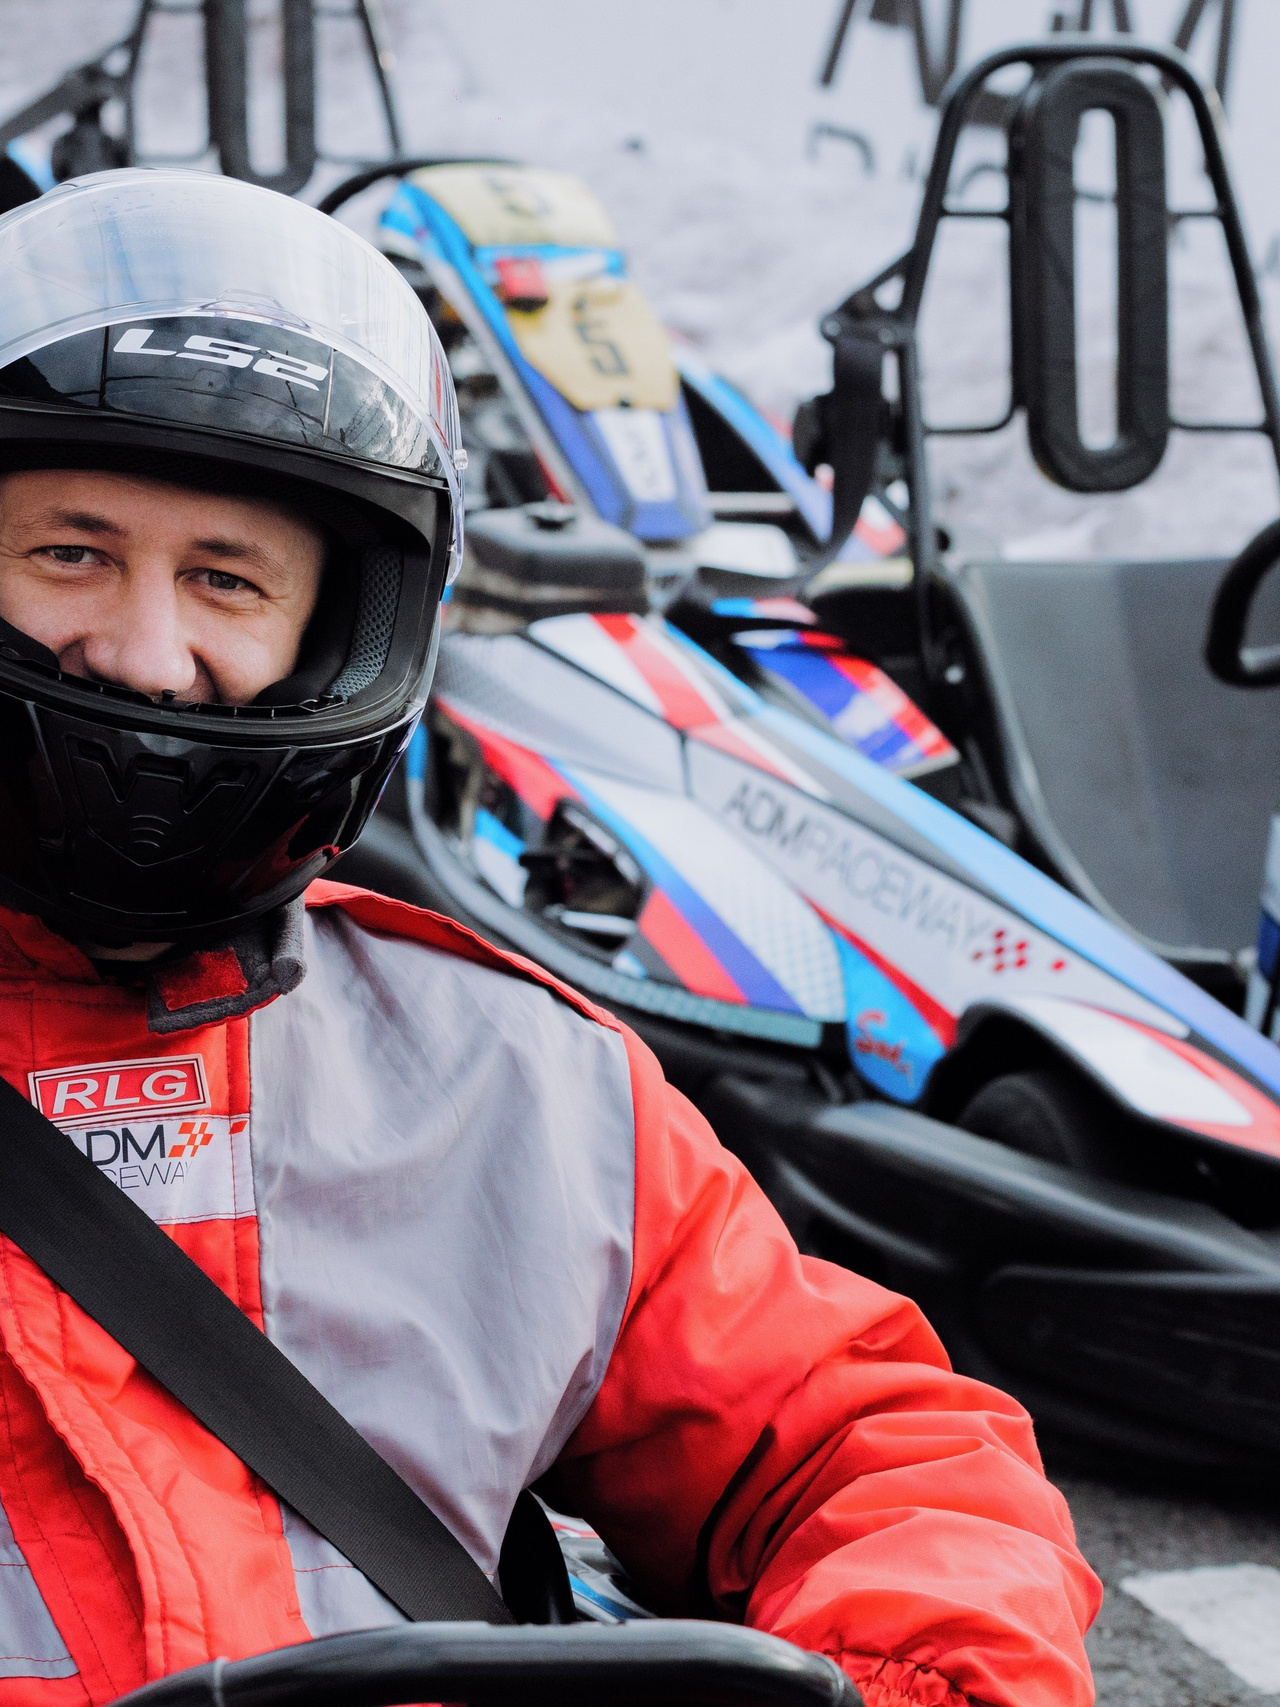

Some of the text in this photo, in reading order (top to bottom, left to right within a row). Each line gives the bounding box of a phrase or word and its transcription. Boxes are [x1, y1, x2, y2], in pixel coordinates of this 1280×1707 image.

[113, 328, 329, 391] LS2
[52, 1070, 187, 1114] RLG
[65, 1124, 166, 1167] DM
